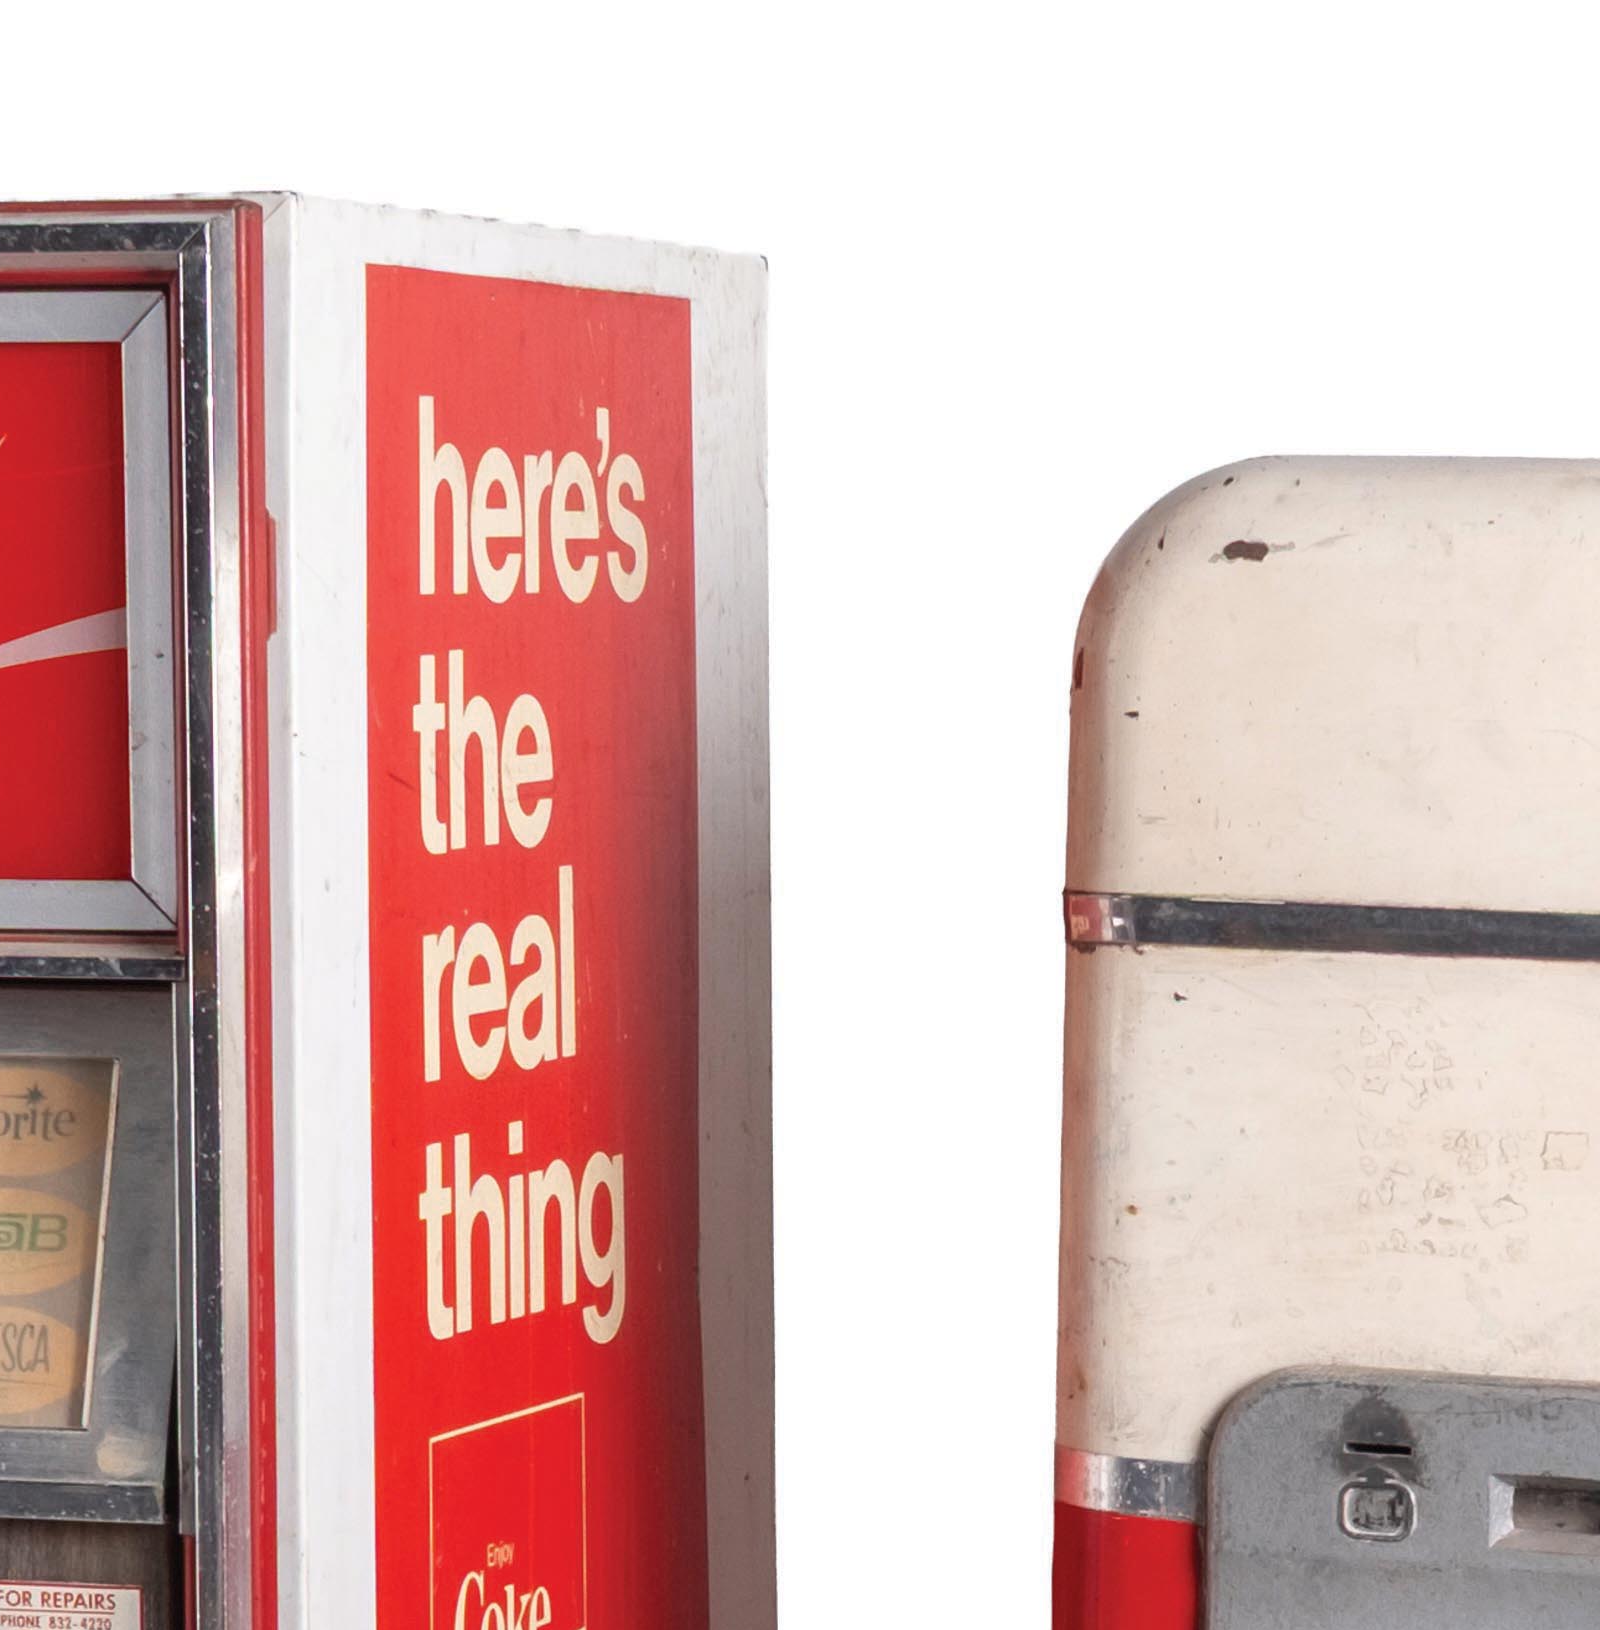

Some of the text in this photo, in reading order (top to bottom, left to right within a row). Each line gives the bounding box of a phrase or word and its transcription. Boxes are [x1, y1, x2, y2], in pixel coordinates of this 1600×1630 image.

[418, 395, 648, 604] here's
[413, 648, 554, 856] the
[420, 865, 577, 1083] real
[418, 1122, 627, 1343] thing
[0, 1614, 41, 1629] PHONE
[40, 1590, 117, 1611] REPAIRS
[486, 1540, 515, 1569] Enjoy
